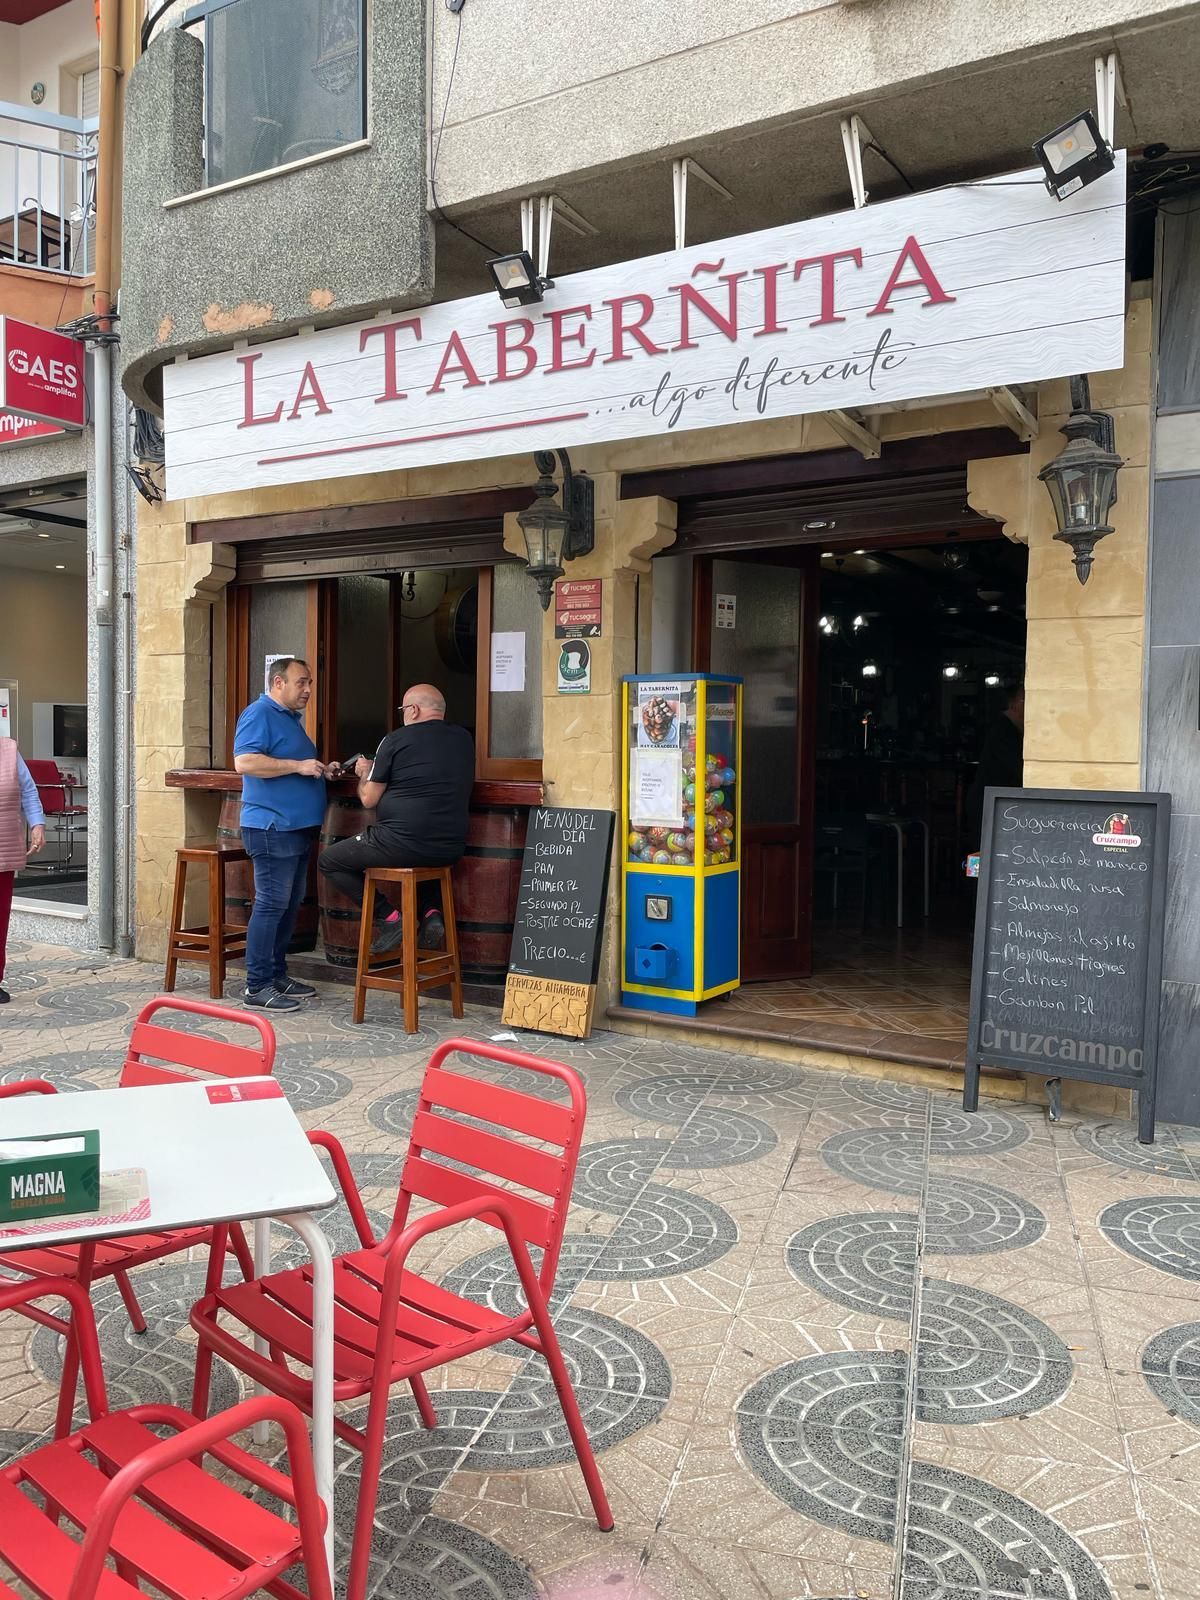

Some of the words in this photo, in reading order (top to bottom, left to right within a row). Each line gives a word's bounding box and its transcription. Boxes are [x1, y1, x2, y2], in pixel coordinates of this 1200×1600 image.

[237, 352, 333, 430] LA
[359, 234, 957, 405] TABERÑITA
[8, 349, 78, 388] GAES
[724, 328, 915, 414] diferente
[44, 384, 77, 399] amplifon
[535, 809, 573, 829] MENÚ
[575, 813, 596, 830] DEL
[535, 842, 573, 856] BEBIDA
[1096, 835, 1138, 846] Cruzcampo
[534, 862, 555, 875] PAN
[531, 878, 564, 892] PRIMER
[566, 880, 579, 891] PL
[527, 898, 567, 911] SEGUNDO
[570, 901, 583, 913] PL
[525, 913, 560, 929] POSTRE
[507, 976, 543, 991] CERVEZAS
[545, 982, 586, 998] ALHAMBRA
[980, 1020, 1144, 1071] Cruzcampo
[11, 1170, 66, 1200] MAGNA
